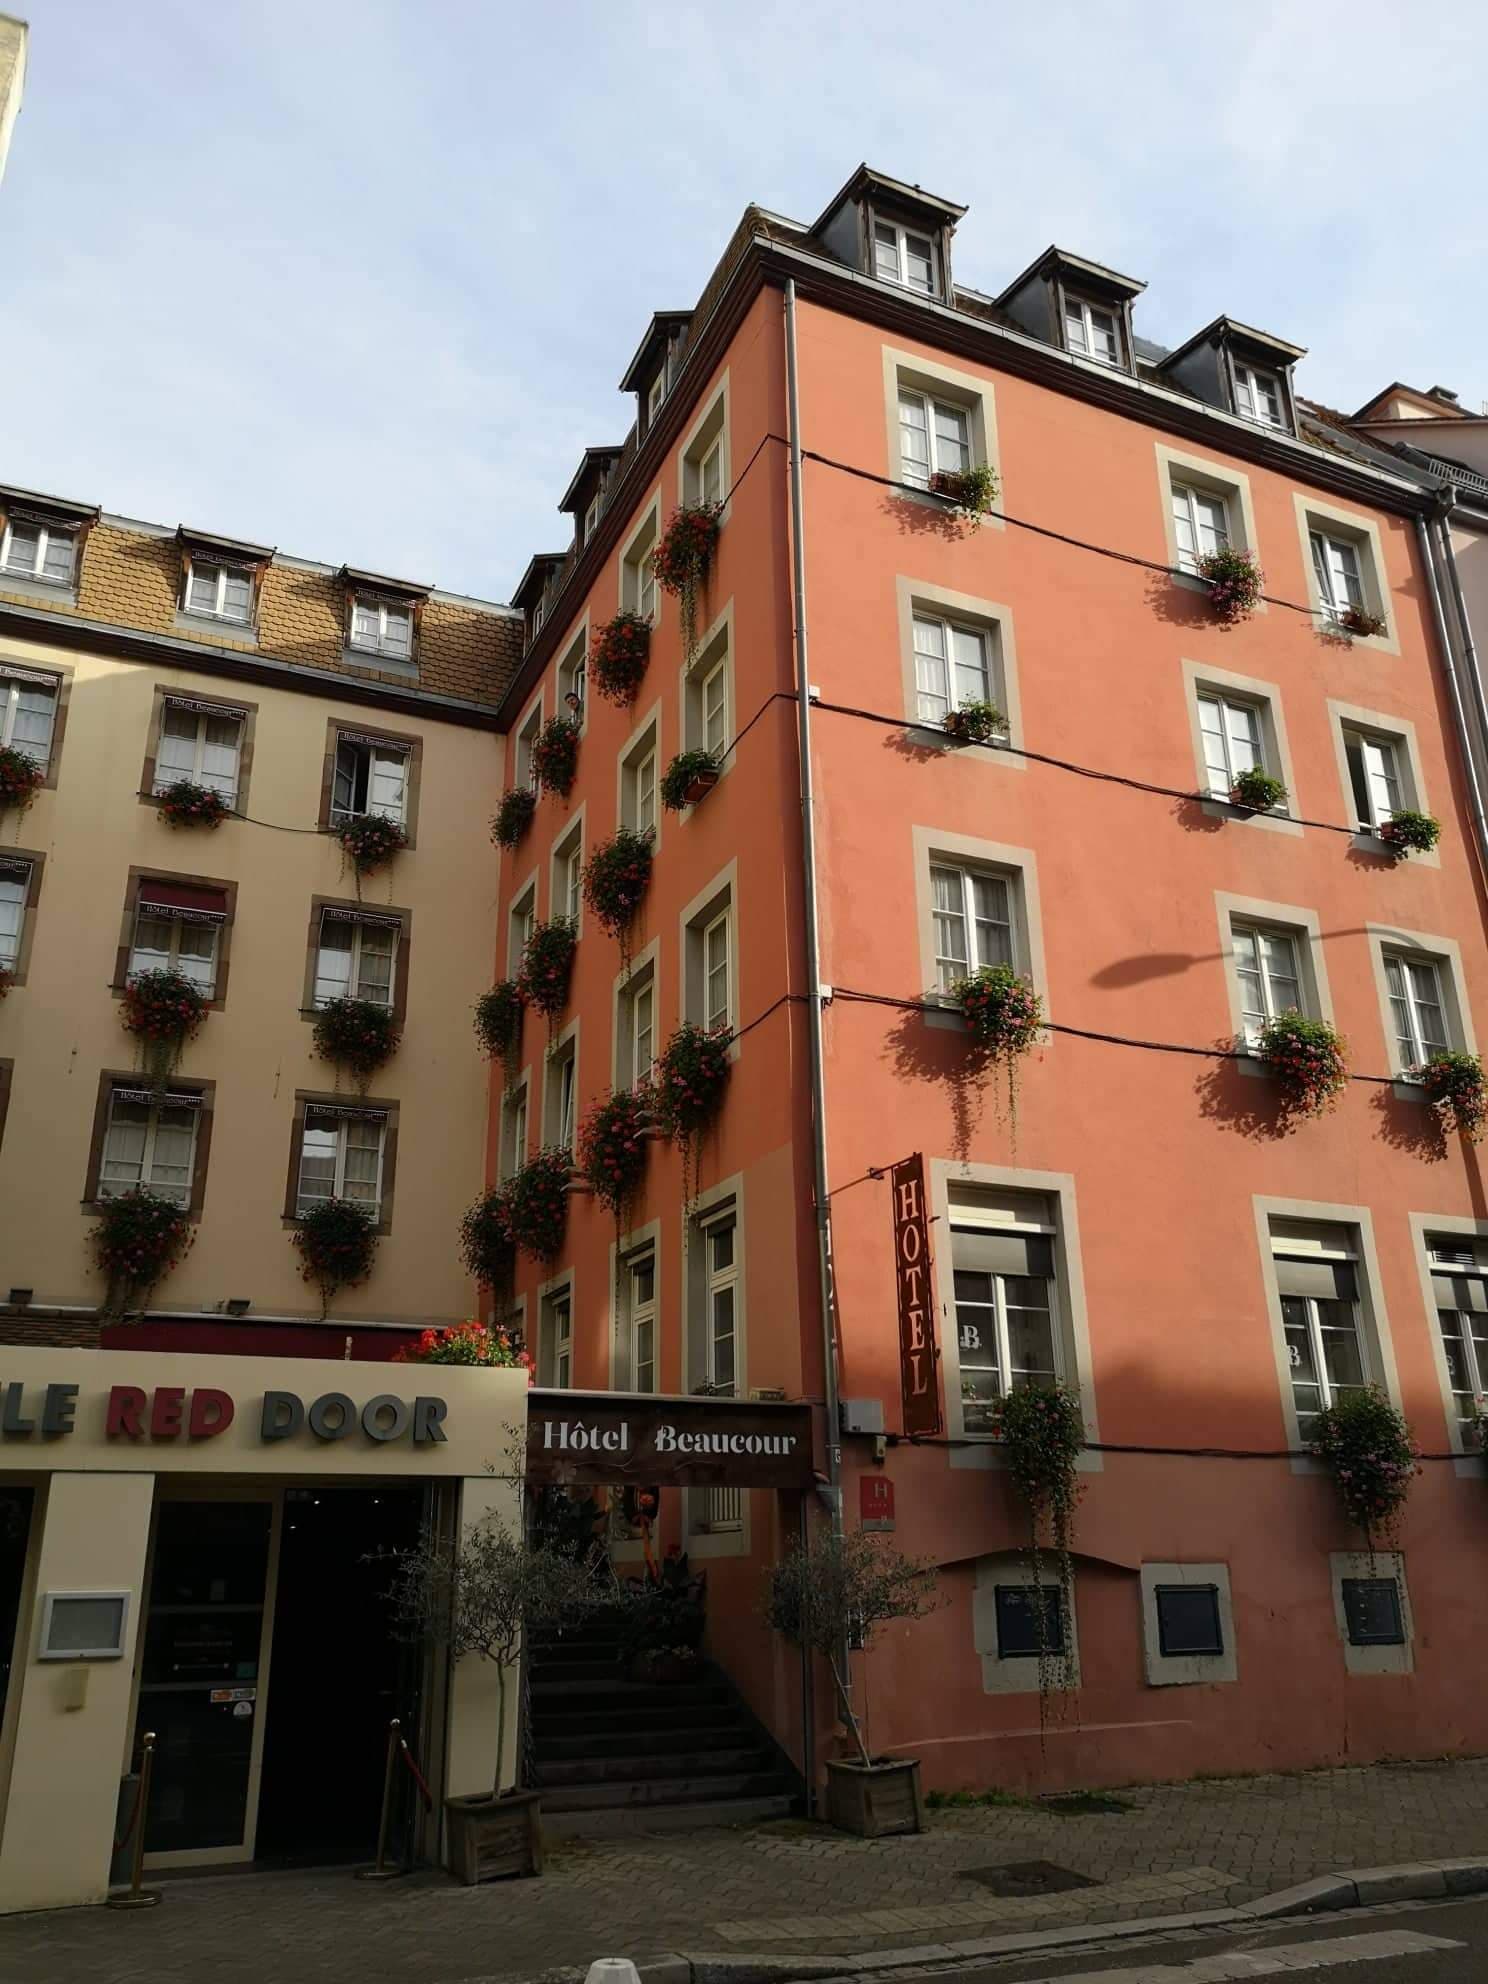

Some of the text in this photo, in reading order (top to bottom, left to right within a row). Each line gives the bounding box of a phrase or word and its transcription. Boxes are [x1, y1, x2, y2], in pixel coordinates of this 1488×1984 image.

[898, 1179, 928, 1396] HOTEL
[0, 1381, 449, 1442] LE RED DOOR
[543, 1420, 797, 1455] Hôtel Beaucour
[874, 1482, 888, 1499] H
